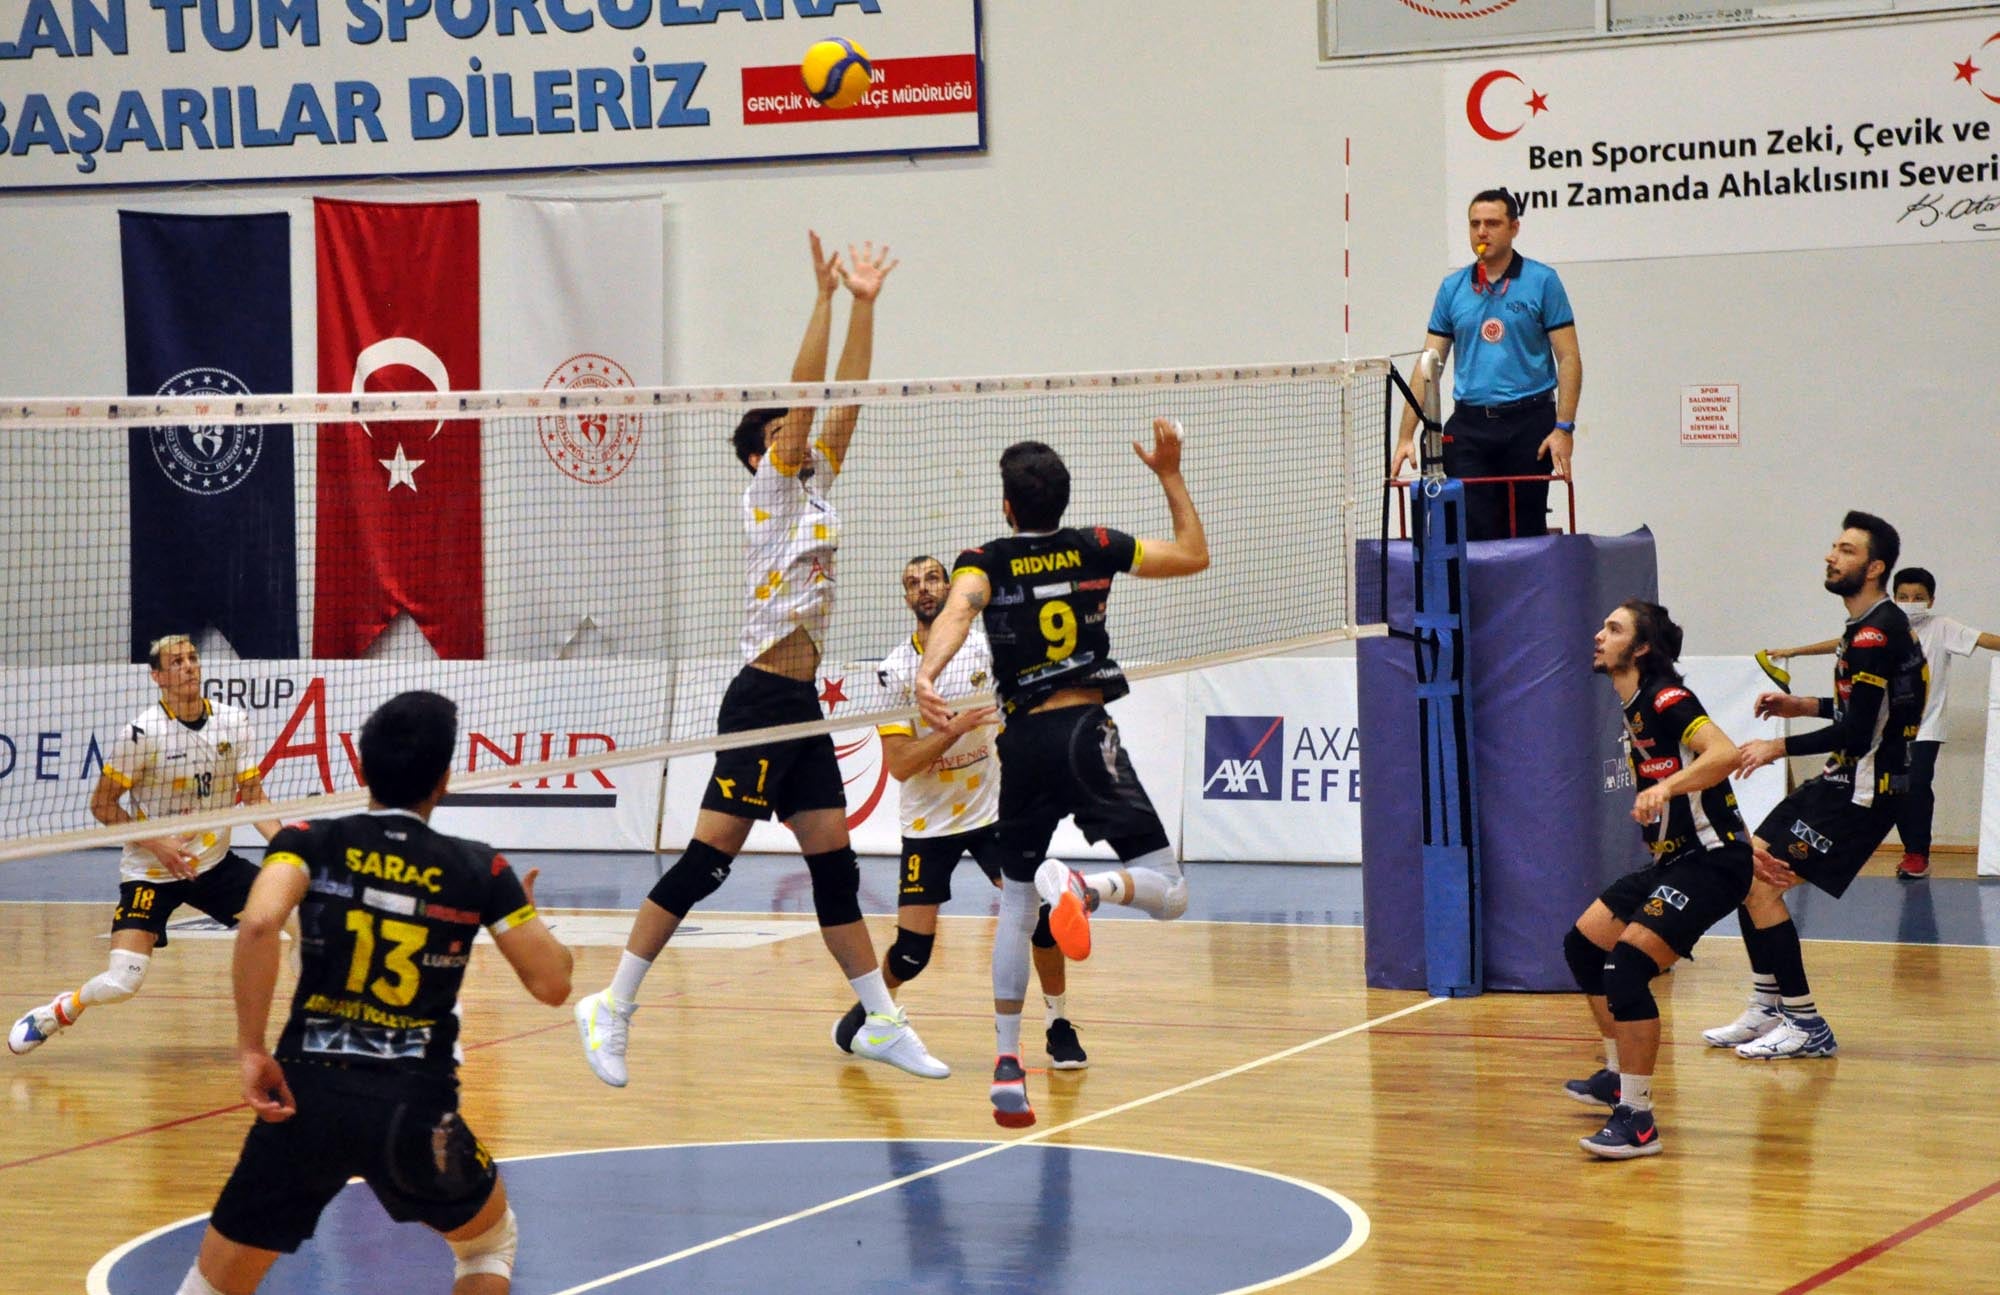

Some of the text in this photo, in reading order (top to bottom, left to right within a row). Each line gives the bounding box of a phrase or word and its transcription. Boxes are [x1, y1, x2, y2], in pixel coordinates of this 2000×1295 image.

[408, 46, 711, 141] DİLERİZ
[746, 92, 803, 115] GENÇLİK
[892, 81, 973, 105] MÜDÜRLÜĞÜ
[1528, 117, 1991, 173] Ben Sporcunun Zeki, Çevik ve
[1499, 186, 1558, 217] ynı
[1566, 174, 1709, 208] Zamanda
[1717, 166, 1889, 199] Ahlaklısını
[1010, 550, 1083, 577] RIDVAN
[1039, 600, 1078, 663] 9
[204, 677, 294, 709] GRUP
[1293, 727, 1360, 761] AXA
[194, 771, 212, 800] 18
[756, 758, 769, 793] 1
[1203, 759, 1269, 793] AXA
[907, 853, 921, 882] 9
[131, 885, 156, 911] 18
[345, 908, 430, 1008] 13
